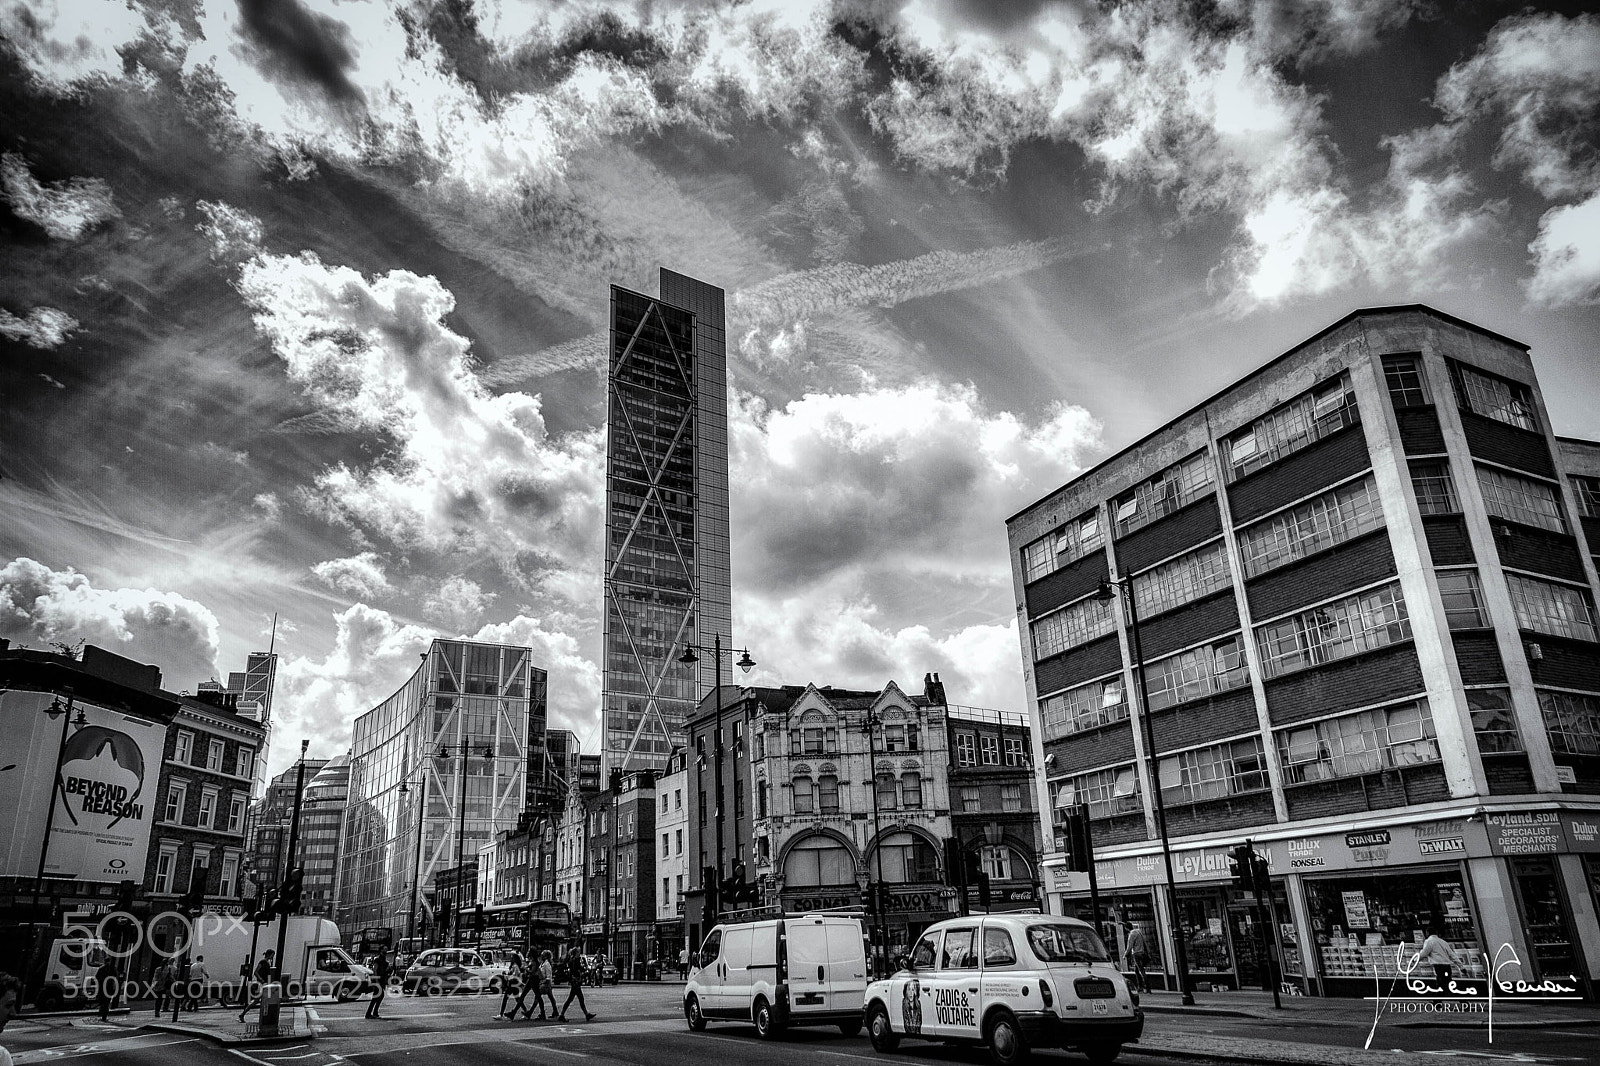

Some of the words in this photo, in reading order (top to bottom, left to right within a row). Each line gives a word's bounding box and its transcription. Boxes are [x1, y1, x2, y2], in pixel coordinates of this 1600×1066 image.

[66, 776, 128, 802] BEYOND
[82, 796, 144, 820] REASON
[1486, 812, 1533, 826] Leyland
[1502, 827, 1551, 837] SPECIALIST
[1572, 822, 1599, 834] Dulux
[1288, 839, 1320, 851] Dulux
[1348, 832, 1388, 846] STANLEY
[1499, 835, 1560, 846] DECORATORS'
[1503, 844, 1557, 853] MERCHANTS
[1136, 856, 1160, 866] Dulux
[1290, 857, 1325, 868] RONSEAL
[935, 988, 960, 1007] ZADIG
[961, 991, 969, 1007] &
[935, 1006, 977, 1027] VOLTAIRE
